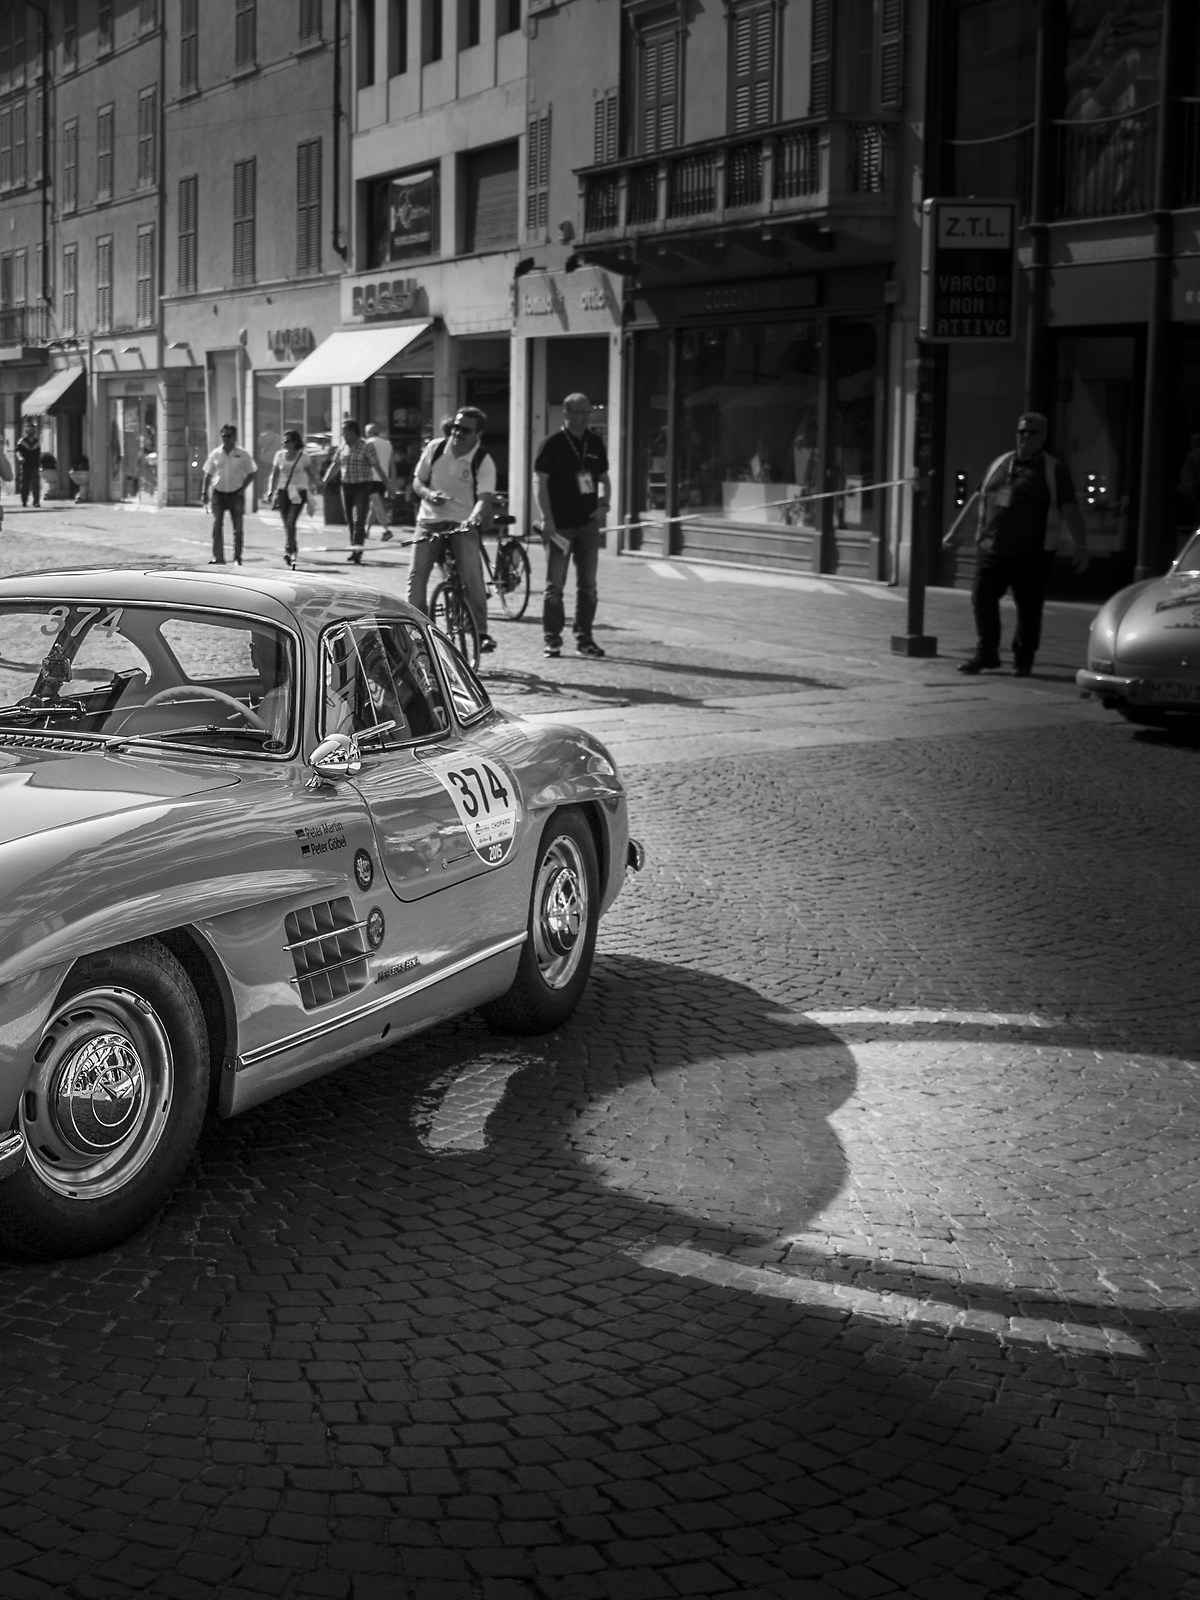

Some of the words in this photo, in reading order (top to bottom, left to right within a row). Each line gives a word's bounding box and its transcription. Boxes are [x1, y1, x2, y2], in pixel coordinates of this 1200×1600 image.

[945, 217, 1005, 237] Z.T.L.
[938, 275, 997, 292] VARCO
[704, 285, 781, 309] COCCINELLE
[949, 297, 985, 314] NON
[40, 605, 124, 638] 374
[447, 763, 509, 818] 374
[305, 827, 324, 840] Peter
[310, 842, 328, 856] Peter
[327, 834, 348, 851] Göbel
